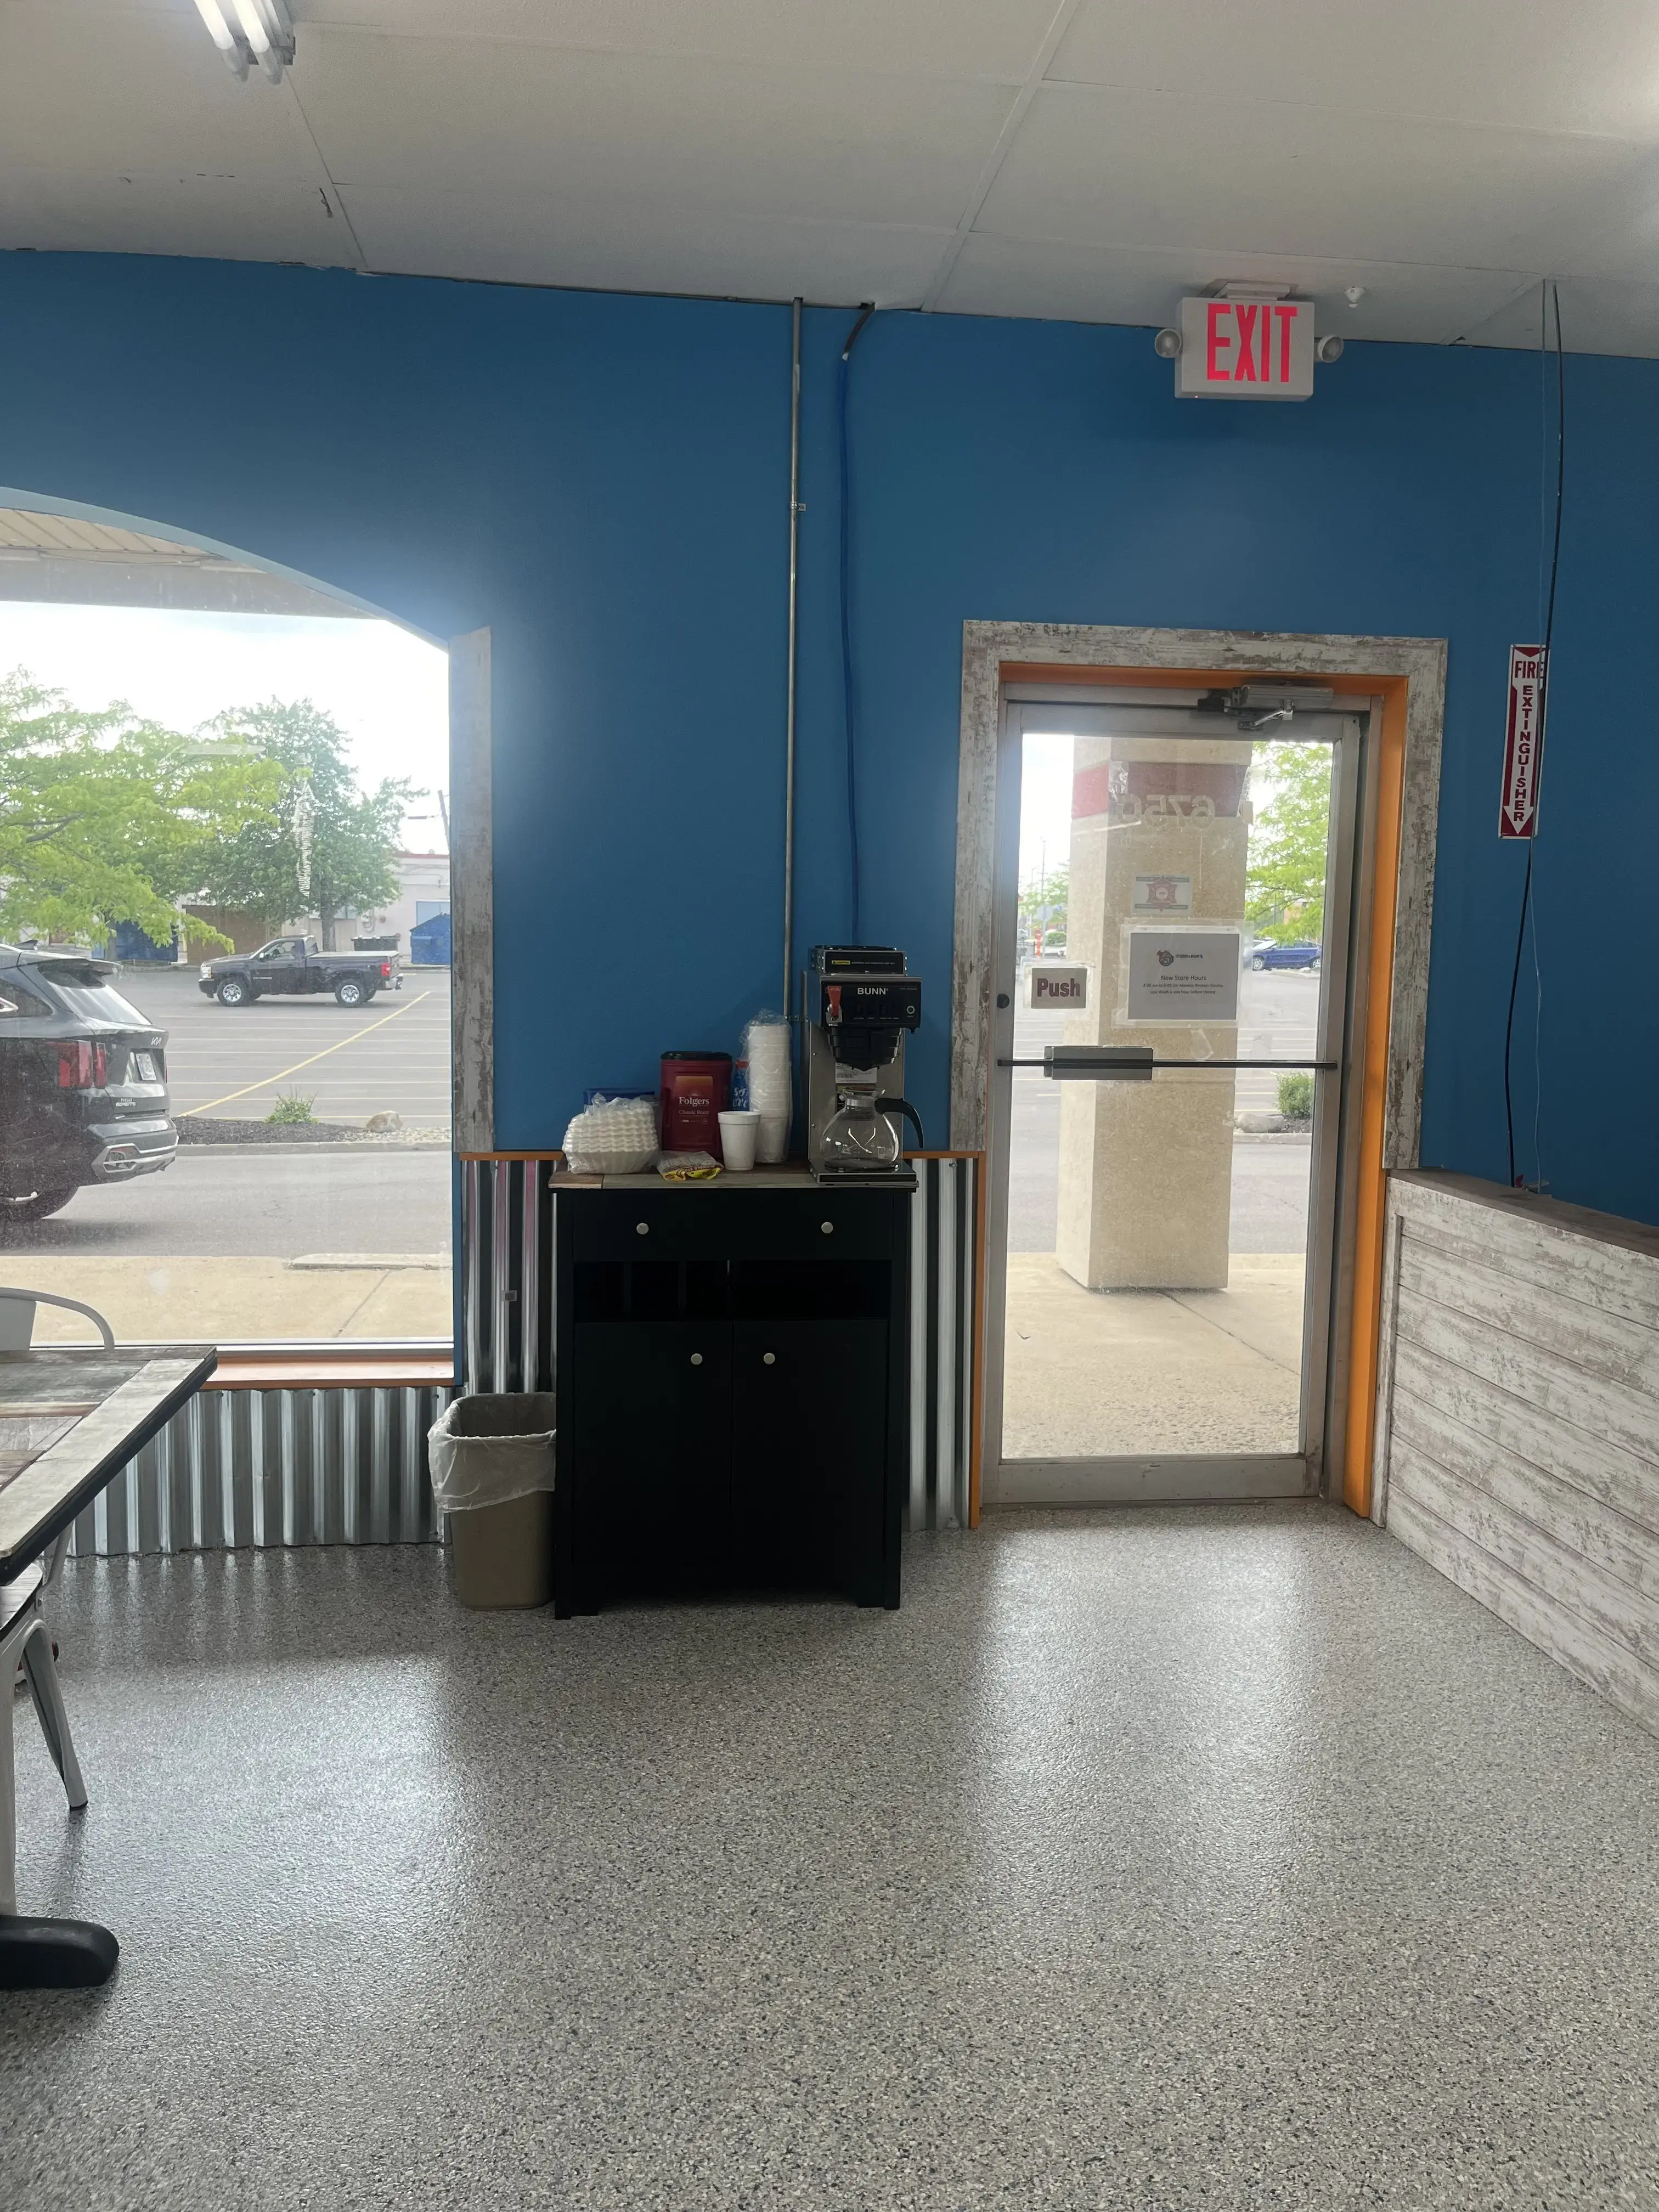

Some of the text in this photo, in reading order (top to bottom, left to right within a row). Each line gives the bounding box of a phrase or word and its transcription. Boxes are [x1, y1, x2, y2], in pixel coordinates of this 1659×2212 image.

[1207, 303, 1297, 383] EXIT
[1514, 660, 1544, 679] FIRE
[1513, 685, 1533, 822] EXTINGUISHER
[1037, 978, 1081, 997] Push
[679, 1096, 710, 1107] Folgers
